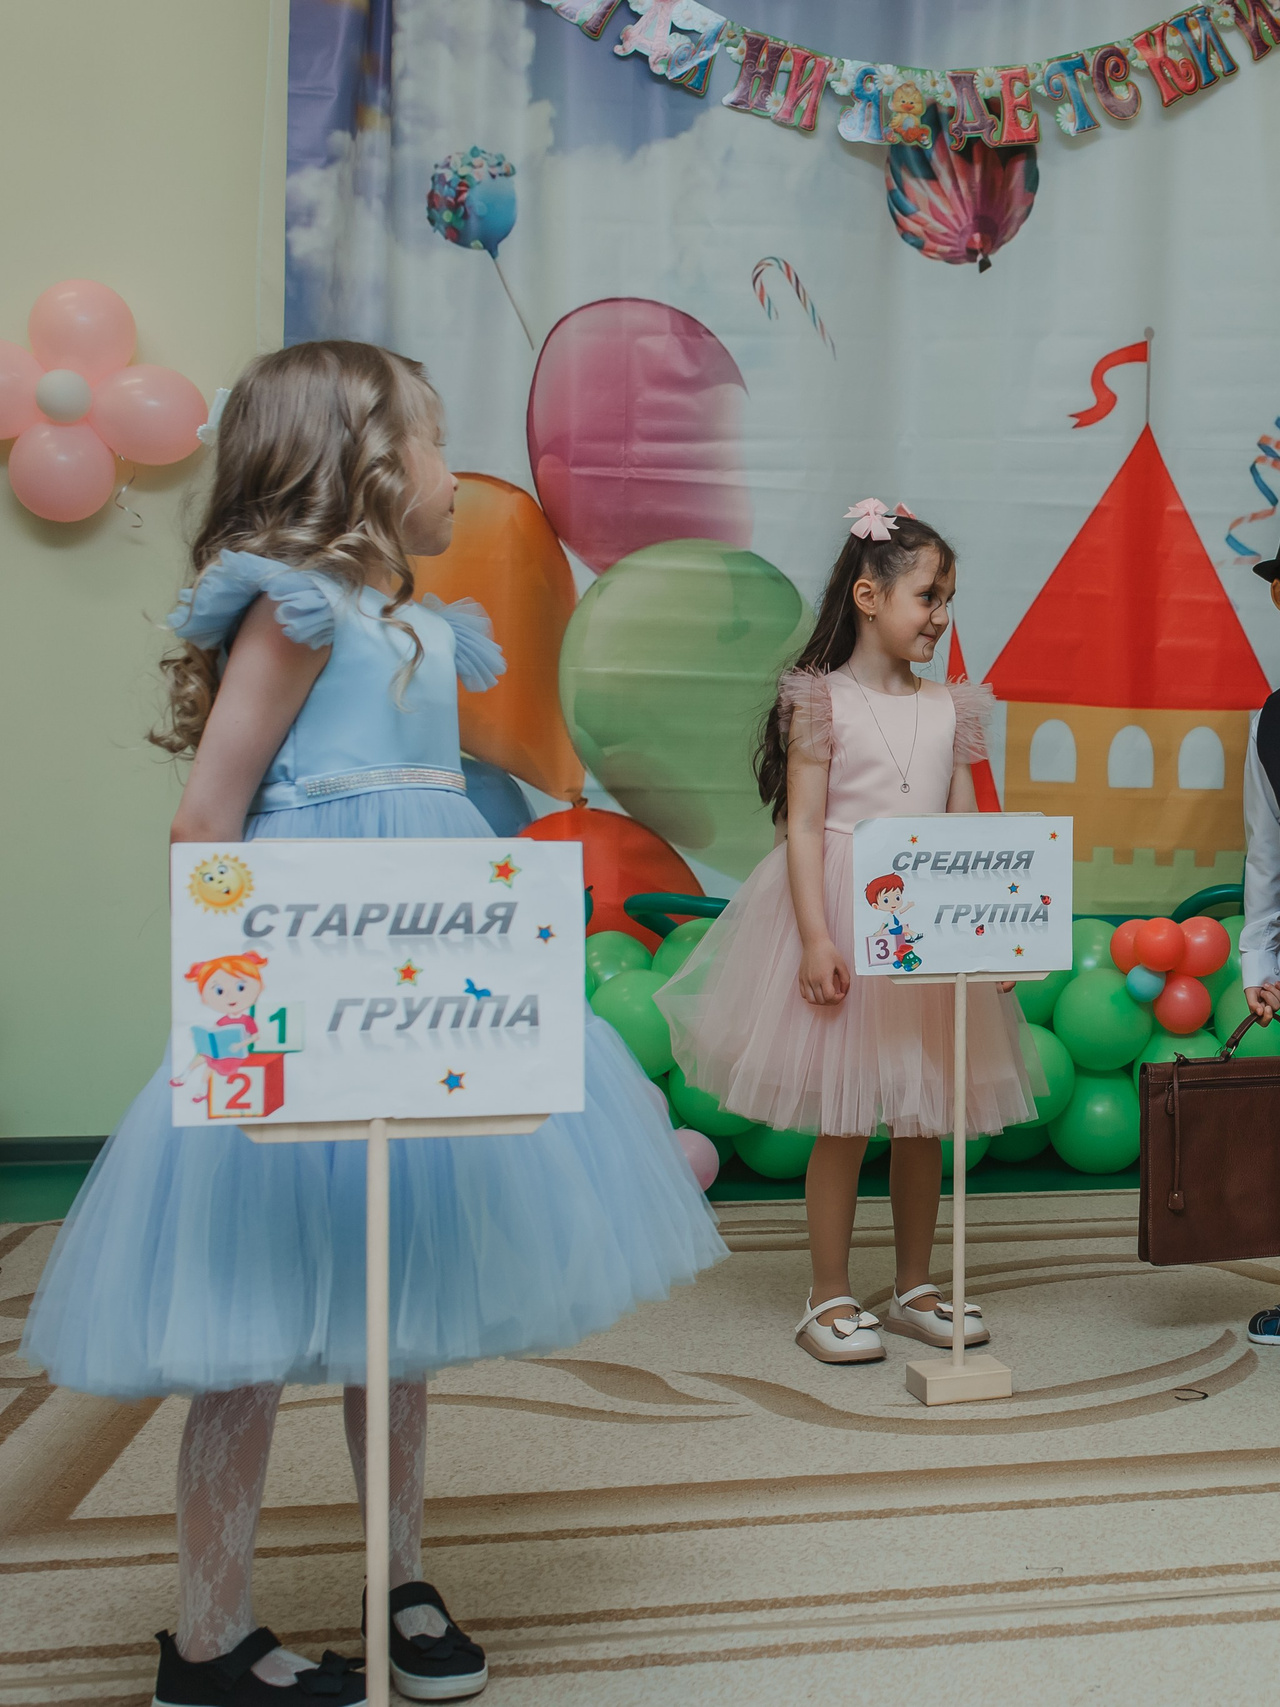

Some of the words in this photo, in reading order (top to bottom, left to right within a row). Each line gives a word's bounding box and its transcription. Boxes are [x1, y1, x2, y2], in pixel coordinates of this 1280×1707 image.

[891, 850, 1035, 875] СРЕДНЯЯ
[242, 901, 519, 939] СТАРШАЯ
[934, 903, 1049, 925] ГРУППА
[875, 938, 890, 960] 3
[268, 1006, 288, 1044] 1
[327, 994, 540, 1032] ГРУППА
[224, 1073, 252, 1110] 2
